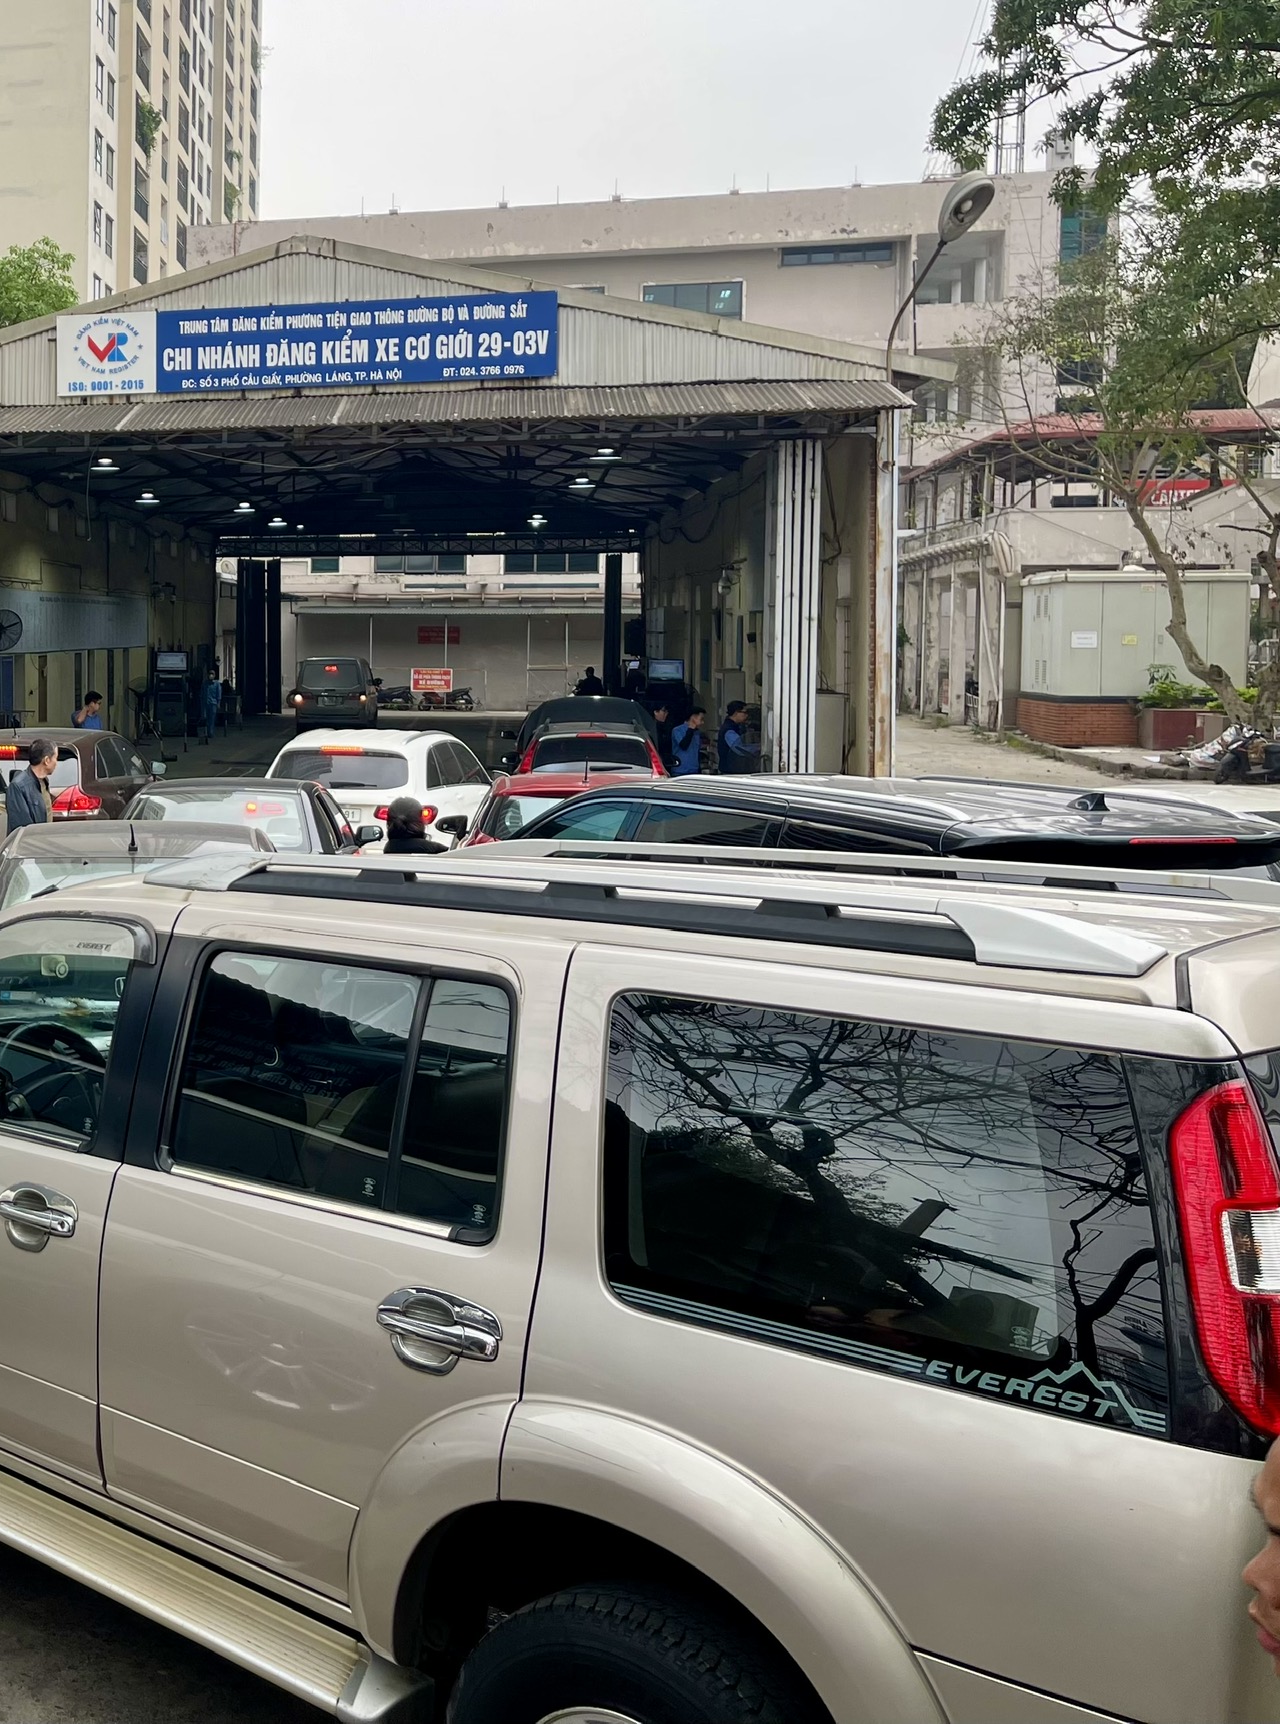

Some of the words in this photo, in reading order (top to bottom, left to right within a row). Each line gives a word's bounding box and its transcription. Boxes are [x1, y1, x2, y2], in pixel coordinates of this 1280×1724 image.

[179, 320, 208, 334] TRUNG
[210, 317, 228, 332] TÂM
[232, 316, 257, 331] ĐĂNG
[260, 311, 283, 330] KIỂM
[286, 313, 323, 329] PHƯƠNG
[326, 311, 347, 329] TIỆN
[351, 311, 371, 326] GIAO
[374, 308, 404, 324] THÔNG
[407, 305, 439, 323] ĐƯỜNG
[442, 304, 455, 324] BỘ
[457, 304, 469, 321] VÀ
[473, 302, 506, 320] ĐƯỜNG
[510, 299, 528, 319] SẮT
[111, 318, 125, 326] VIỆT
[126, 324, 139, 337] NAM
[163, 347, 192, 371] CHI
[197, 341, 260, 369] NHÁNH
[266, 339, 316, 367] ĐĂNG
[321, 329, 369, 365] KIỂM
[375, 338, 399, 362] XE
[405, 333, 431, 360] CƠ
[435, 329, 473, 359] GIỚI
[478, 330, 549, 358] 29-03V
[78, 356, 90, 368] VIET
[109, 355, 139, 374] REGISTER
[443, 368, 458, 377] ĐT:
[460, 367, 478, 376] 024.
[480, 366, 500, 375] 3766
[504, 364, 524, 374] 0976
[68, 382, 87, 392] ISO:
[91, 381, 112, 391] 9001
[121, 380, 144, 390] 2015
[182, 379, 197, 388] ĐC:
[200, 374, 213, 387] SỐ
[214, 378, 218, 387] 3
[221, 373, 239, 387] PHỐ
[262, 371, 282, 386] GIẤY,
[285, 371, 321, 385] PHƯỜNG
[326, 370, 353, 385] LÁNG,
[355, 371, 368, 381] TP.
[370, 369, 383, 380] HÀ
[386, 368, 402, 381] NỘI
[925, 1360, 1119, 1417] EVEREST
